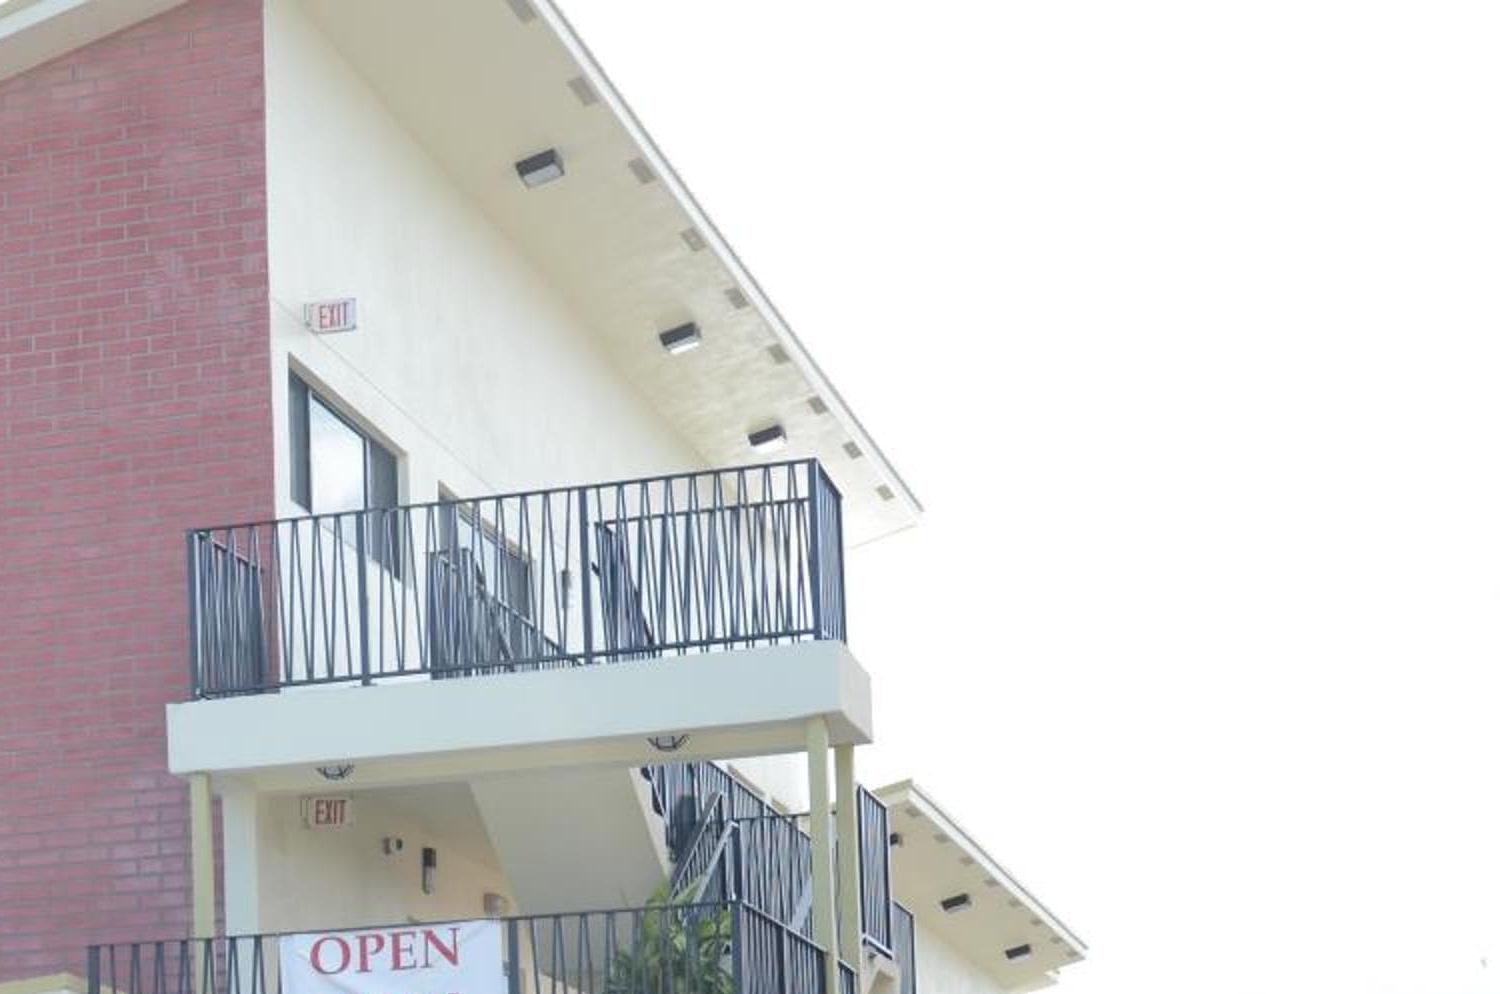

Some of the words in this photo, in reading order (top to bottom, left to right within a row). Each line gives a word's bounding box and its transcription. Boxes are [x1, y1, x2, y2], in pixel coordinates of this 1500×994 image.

[319, 302, 349, 329] EXIT
[315, 799, 347, 825] EXIT
[309, 927, 461, 975] OPEN
